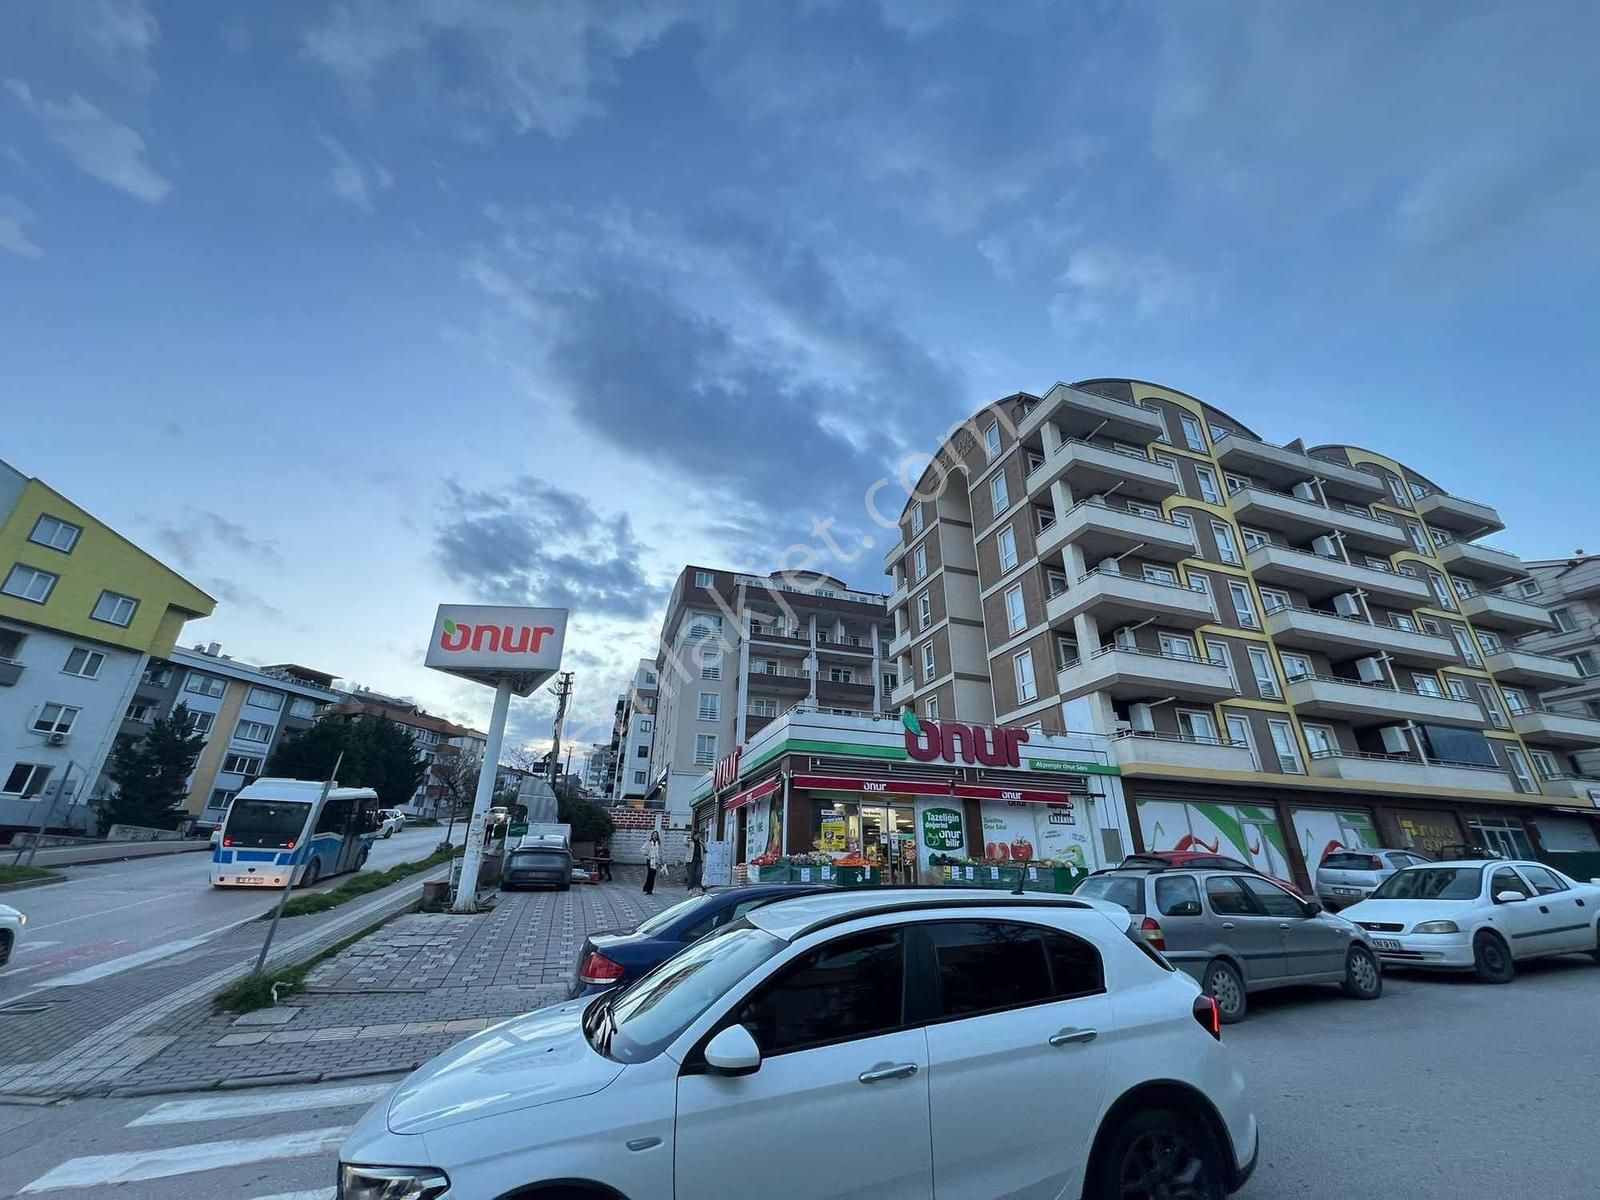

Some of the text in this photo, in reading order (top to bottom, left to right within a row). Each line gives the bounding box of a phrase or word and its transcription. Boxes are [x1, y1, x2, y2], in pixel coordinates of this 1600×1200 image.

[440, 620, 556, 654] onur
[905, 717, 1030, 768] onur
[863, 781, 888, 791] onur
[1001, 790, 1024, 799] onur
[926, 812, 960, 824] Tazeliğin
[939, 830, 962, 839] onur
[945, 839, 960, 847] bilir
